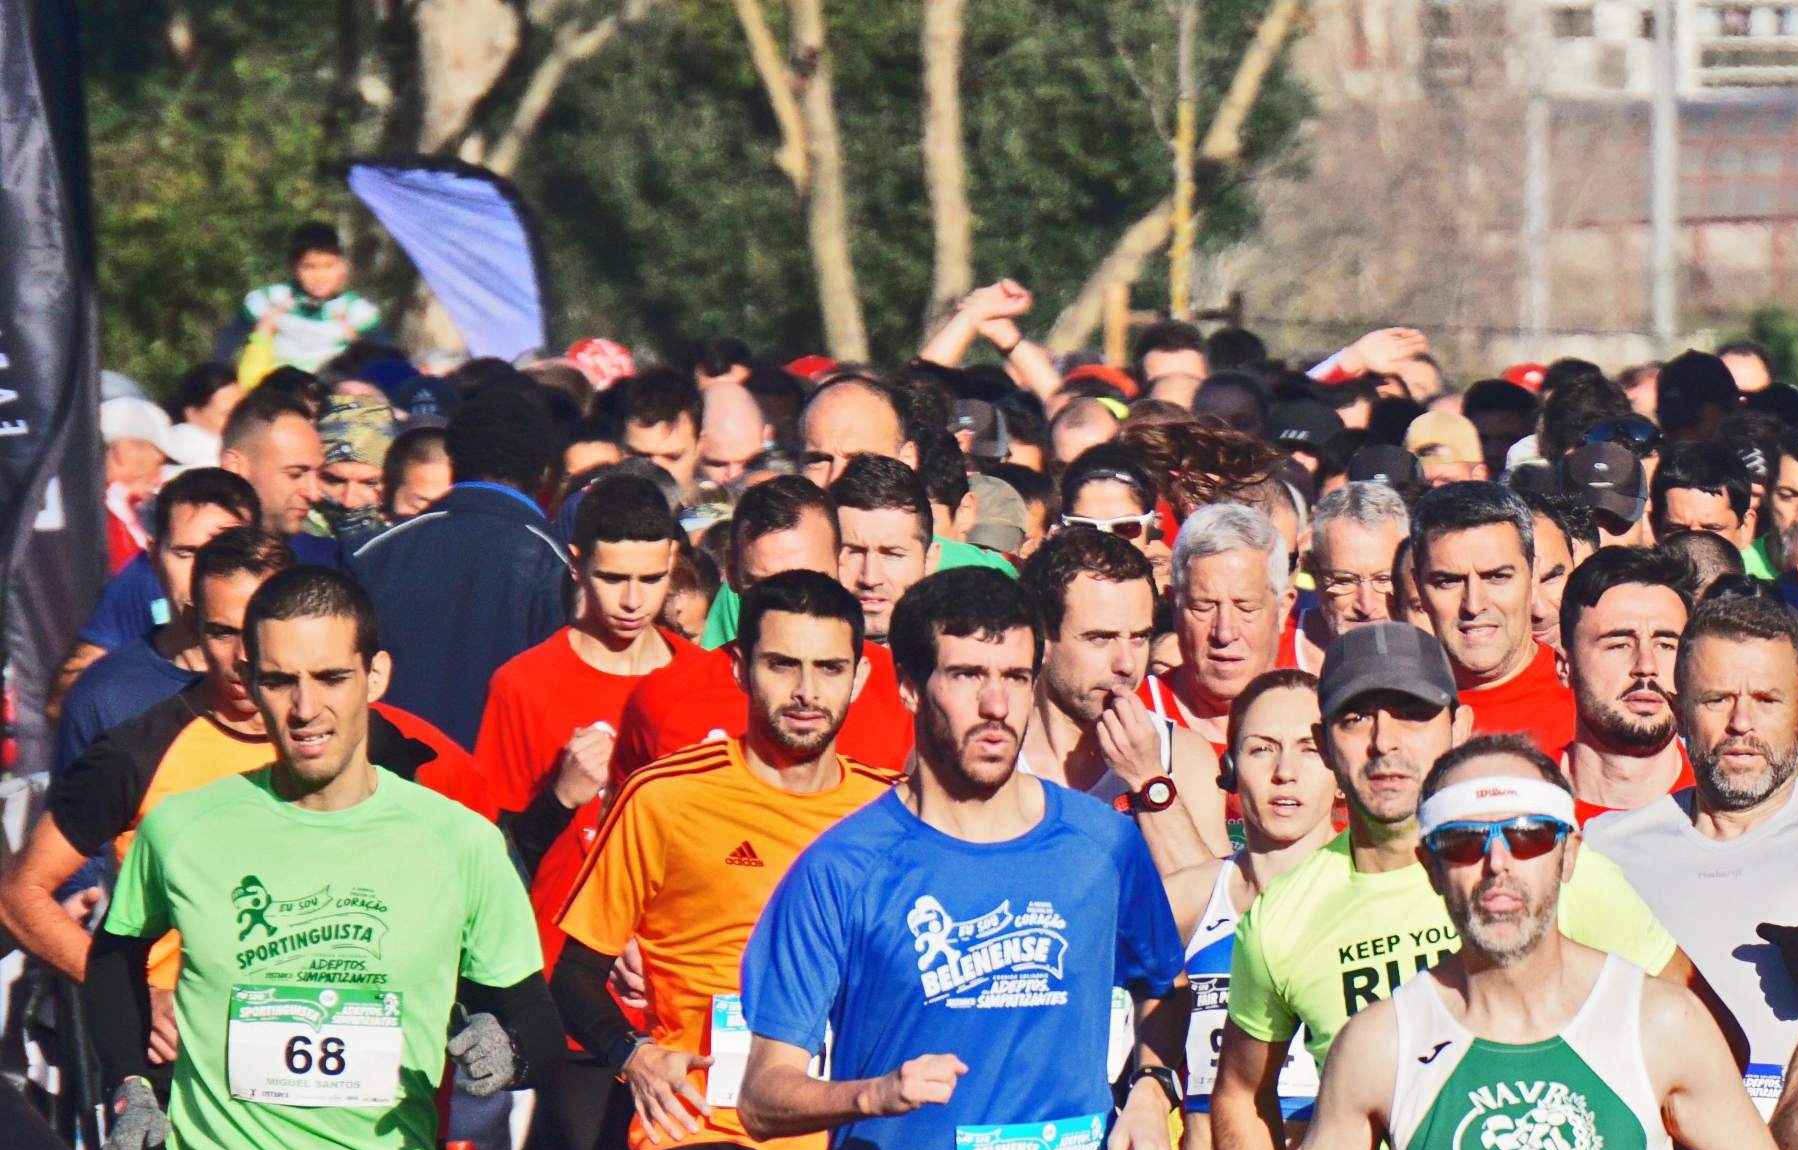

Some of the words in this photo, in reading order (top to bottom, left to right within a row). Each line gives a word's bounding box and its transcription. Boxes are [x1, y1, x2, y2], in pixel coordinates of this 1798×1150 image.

[725, 857, 764, 867] adidas
[279, 903, 293, 912] EU
[299, 897, 318, 909] SOU
[336, 898, 388, 912] CORAÇÃO
[236, 923, 374, 970] SPORTINGUISTA
[1338, 934, 1400, 964] KEEP
[920, 936, 1051, 998] BELENENSE
[296, 970, 388, 985] SIMPATIZANTES
[977, 990, 1069, 1008] SIMPATIZANTES
[239, 1004, 321, 1022] SPORTINGUISTA
[284, 1035, 346, 1076] 68
[266, 1078, 310, 1089] MIGUEL
[316, 1078, 361, 1089] SANTOS
